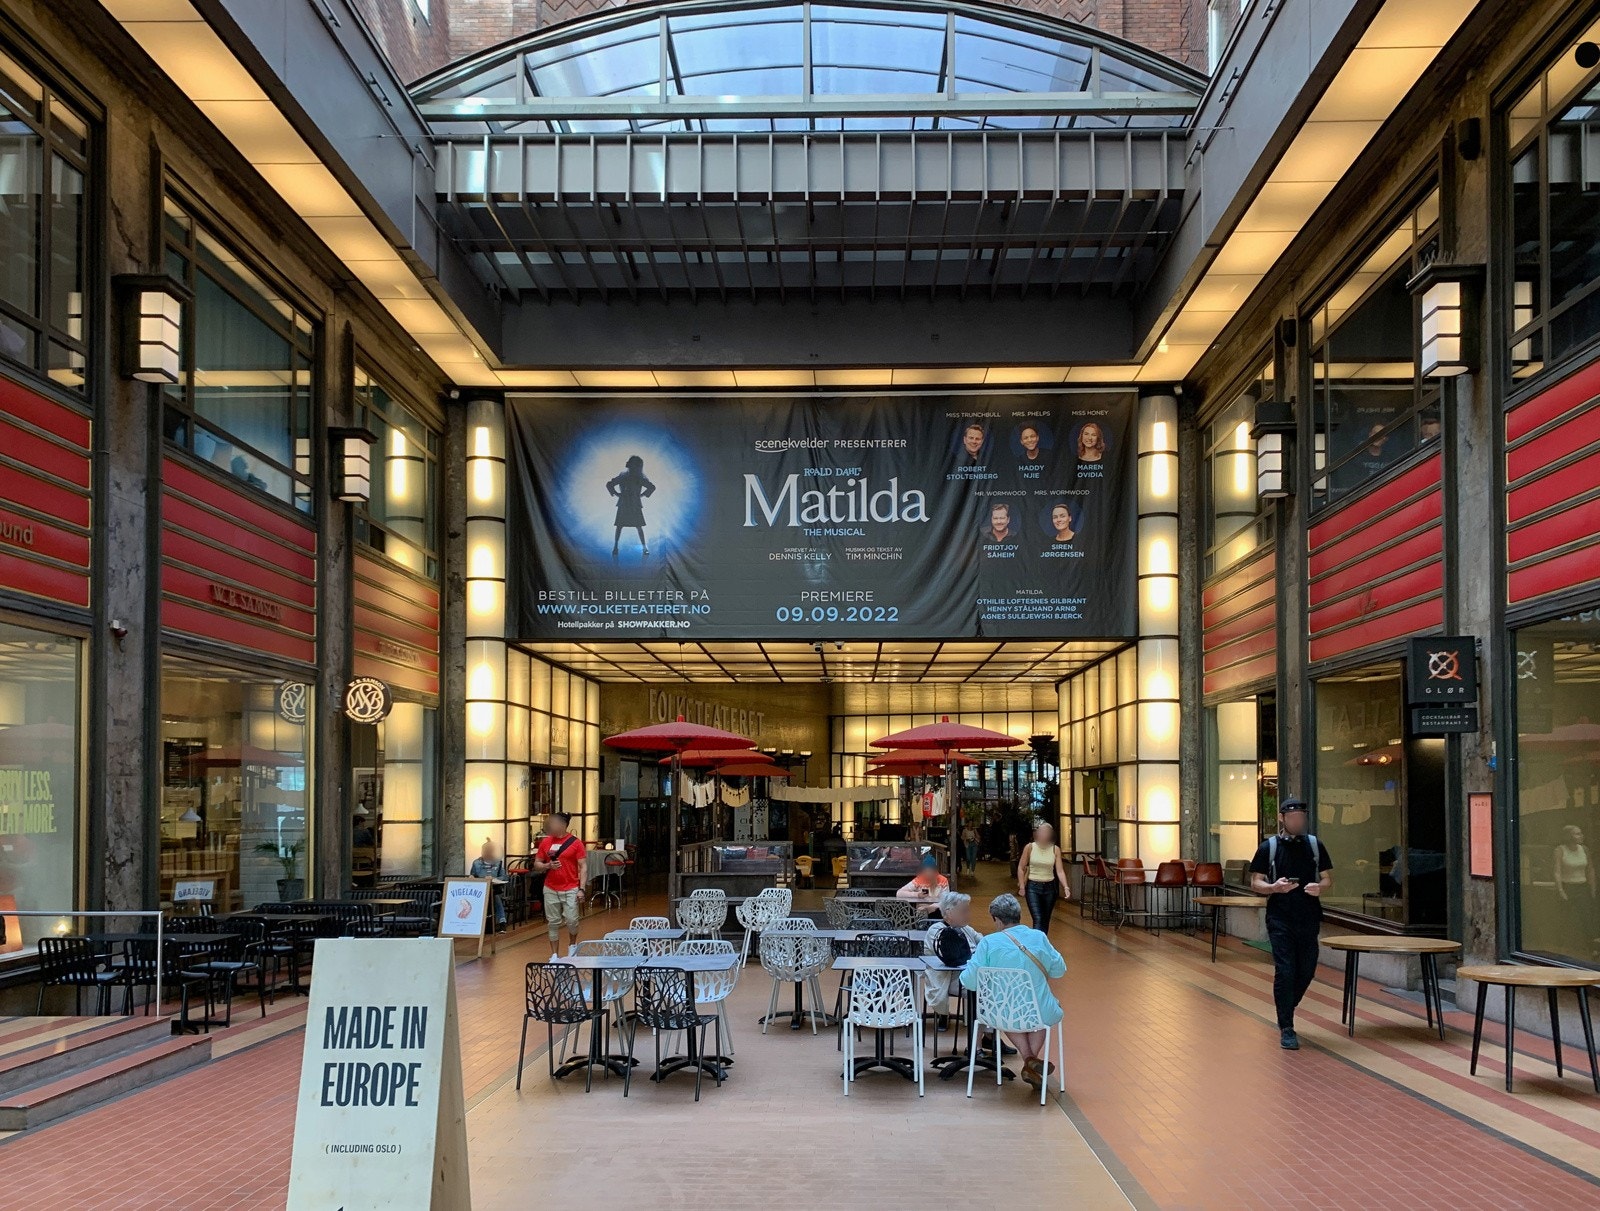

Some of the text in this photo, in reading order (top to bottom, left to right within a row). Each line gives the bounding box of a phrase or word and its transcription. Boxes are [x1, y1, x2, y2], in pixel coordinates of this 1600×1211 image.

[755, 437, 907, 449] scenekvelder PRESENTERER
[804, 468, 833, 477] ROALD
[743, 473, 931, 527] Matilda
[0, 521, 33, 545] und
[804, 528, 866, 536] THE MUSICAL
[538, 588, 710, 601] BESTILL BILLETTER PÅ
[801, 591, 874, 602] PREMIERE
[537, 605, 711, 615] WWW.FOLKETEATERET.NO
[776, 606, 899, 622] 09.09.2022
[557, 620, 691, 630] Hotellpakker på SHOWPAKKER.NO
[649, 688, 765, 737] FOLKETEATERET
[23, 803, 57, 834] MORE.
[451, 888, 483, 898] VIGELAND
[323, 1006, 429, 1050] MADE IN
[320, 1062, 422, 1107] EUROPE
